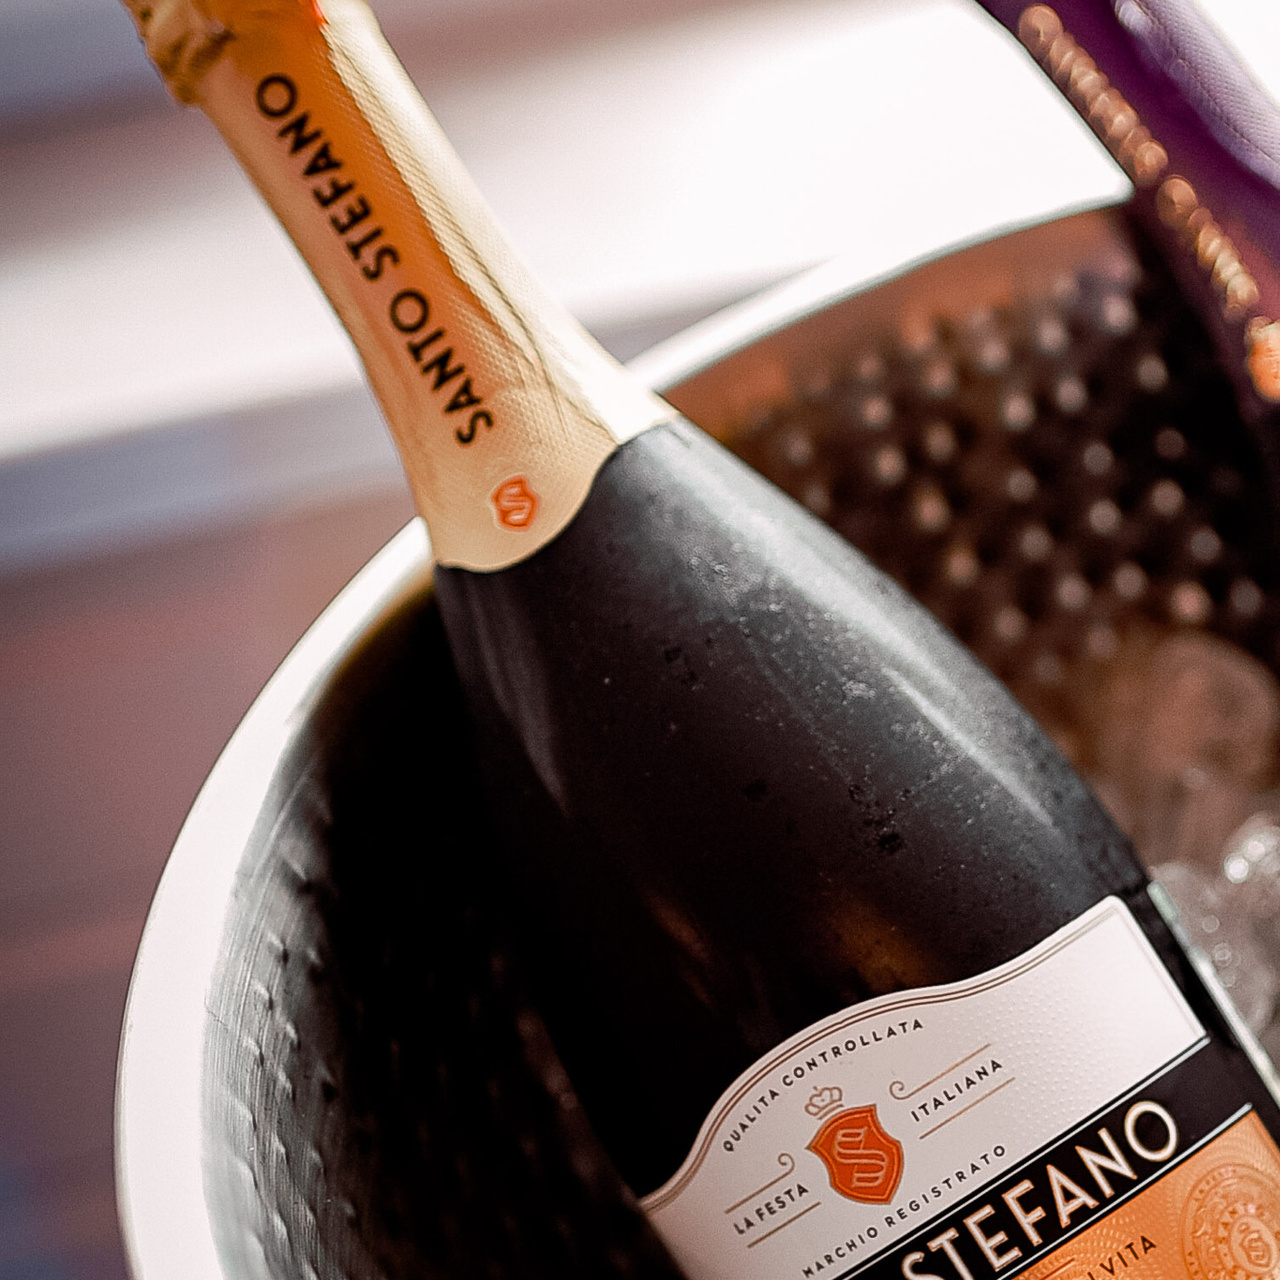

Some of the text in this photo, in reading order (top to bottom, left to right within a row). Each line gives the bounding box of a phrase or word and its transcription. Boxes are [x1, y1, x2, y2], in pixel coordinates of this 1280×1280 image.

[255, 72, 494, 445] SANTO STEFANO
[723, 1018, 924, 1153] QUALITA CONTROLLATA
[910, 1058, 1003, 1123] ITALIANA
[733, 1182, 810, 1236] LA FESTA
[801, 1144, 1006, 1279] MARCHIO REGISTRATO
[1099, 1235, 1157, 1278] VITA
